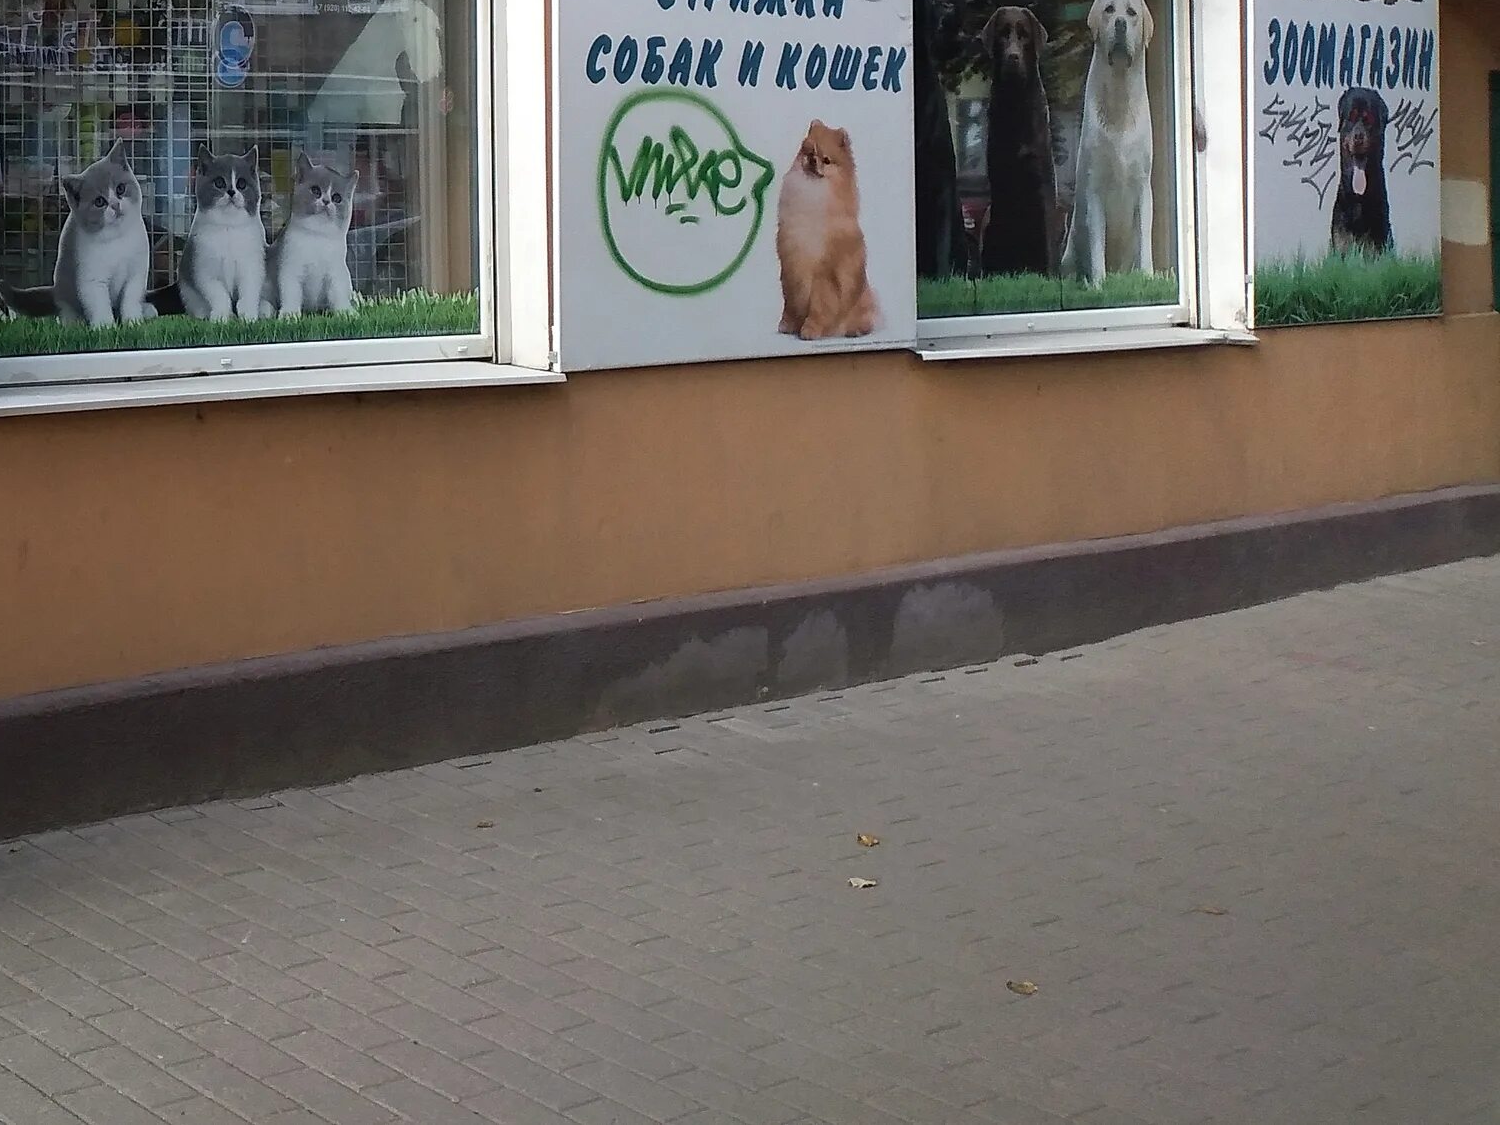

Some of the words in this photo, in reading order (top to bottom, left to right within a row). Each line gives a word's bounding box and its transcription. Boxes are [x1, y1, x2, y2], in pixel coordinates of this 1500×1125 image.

[585, 34, 723, 88] СОБАК
[737, 40, 766, 87] И
[775, 41, 908, 93] КОШЕК
[1263, 18, 1435, 91] ЗООМАГАЗИН
